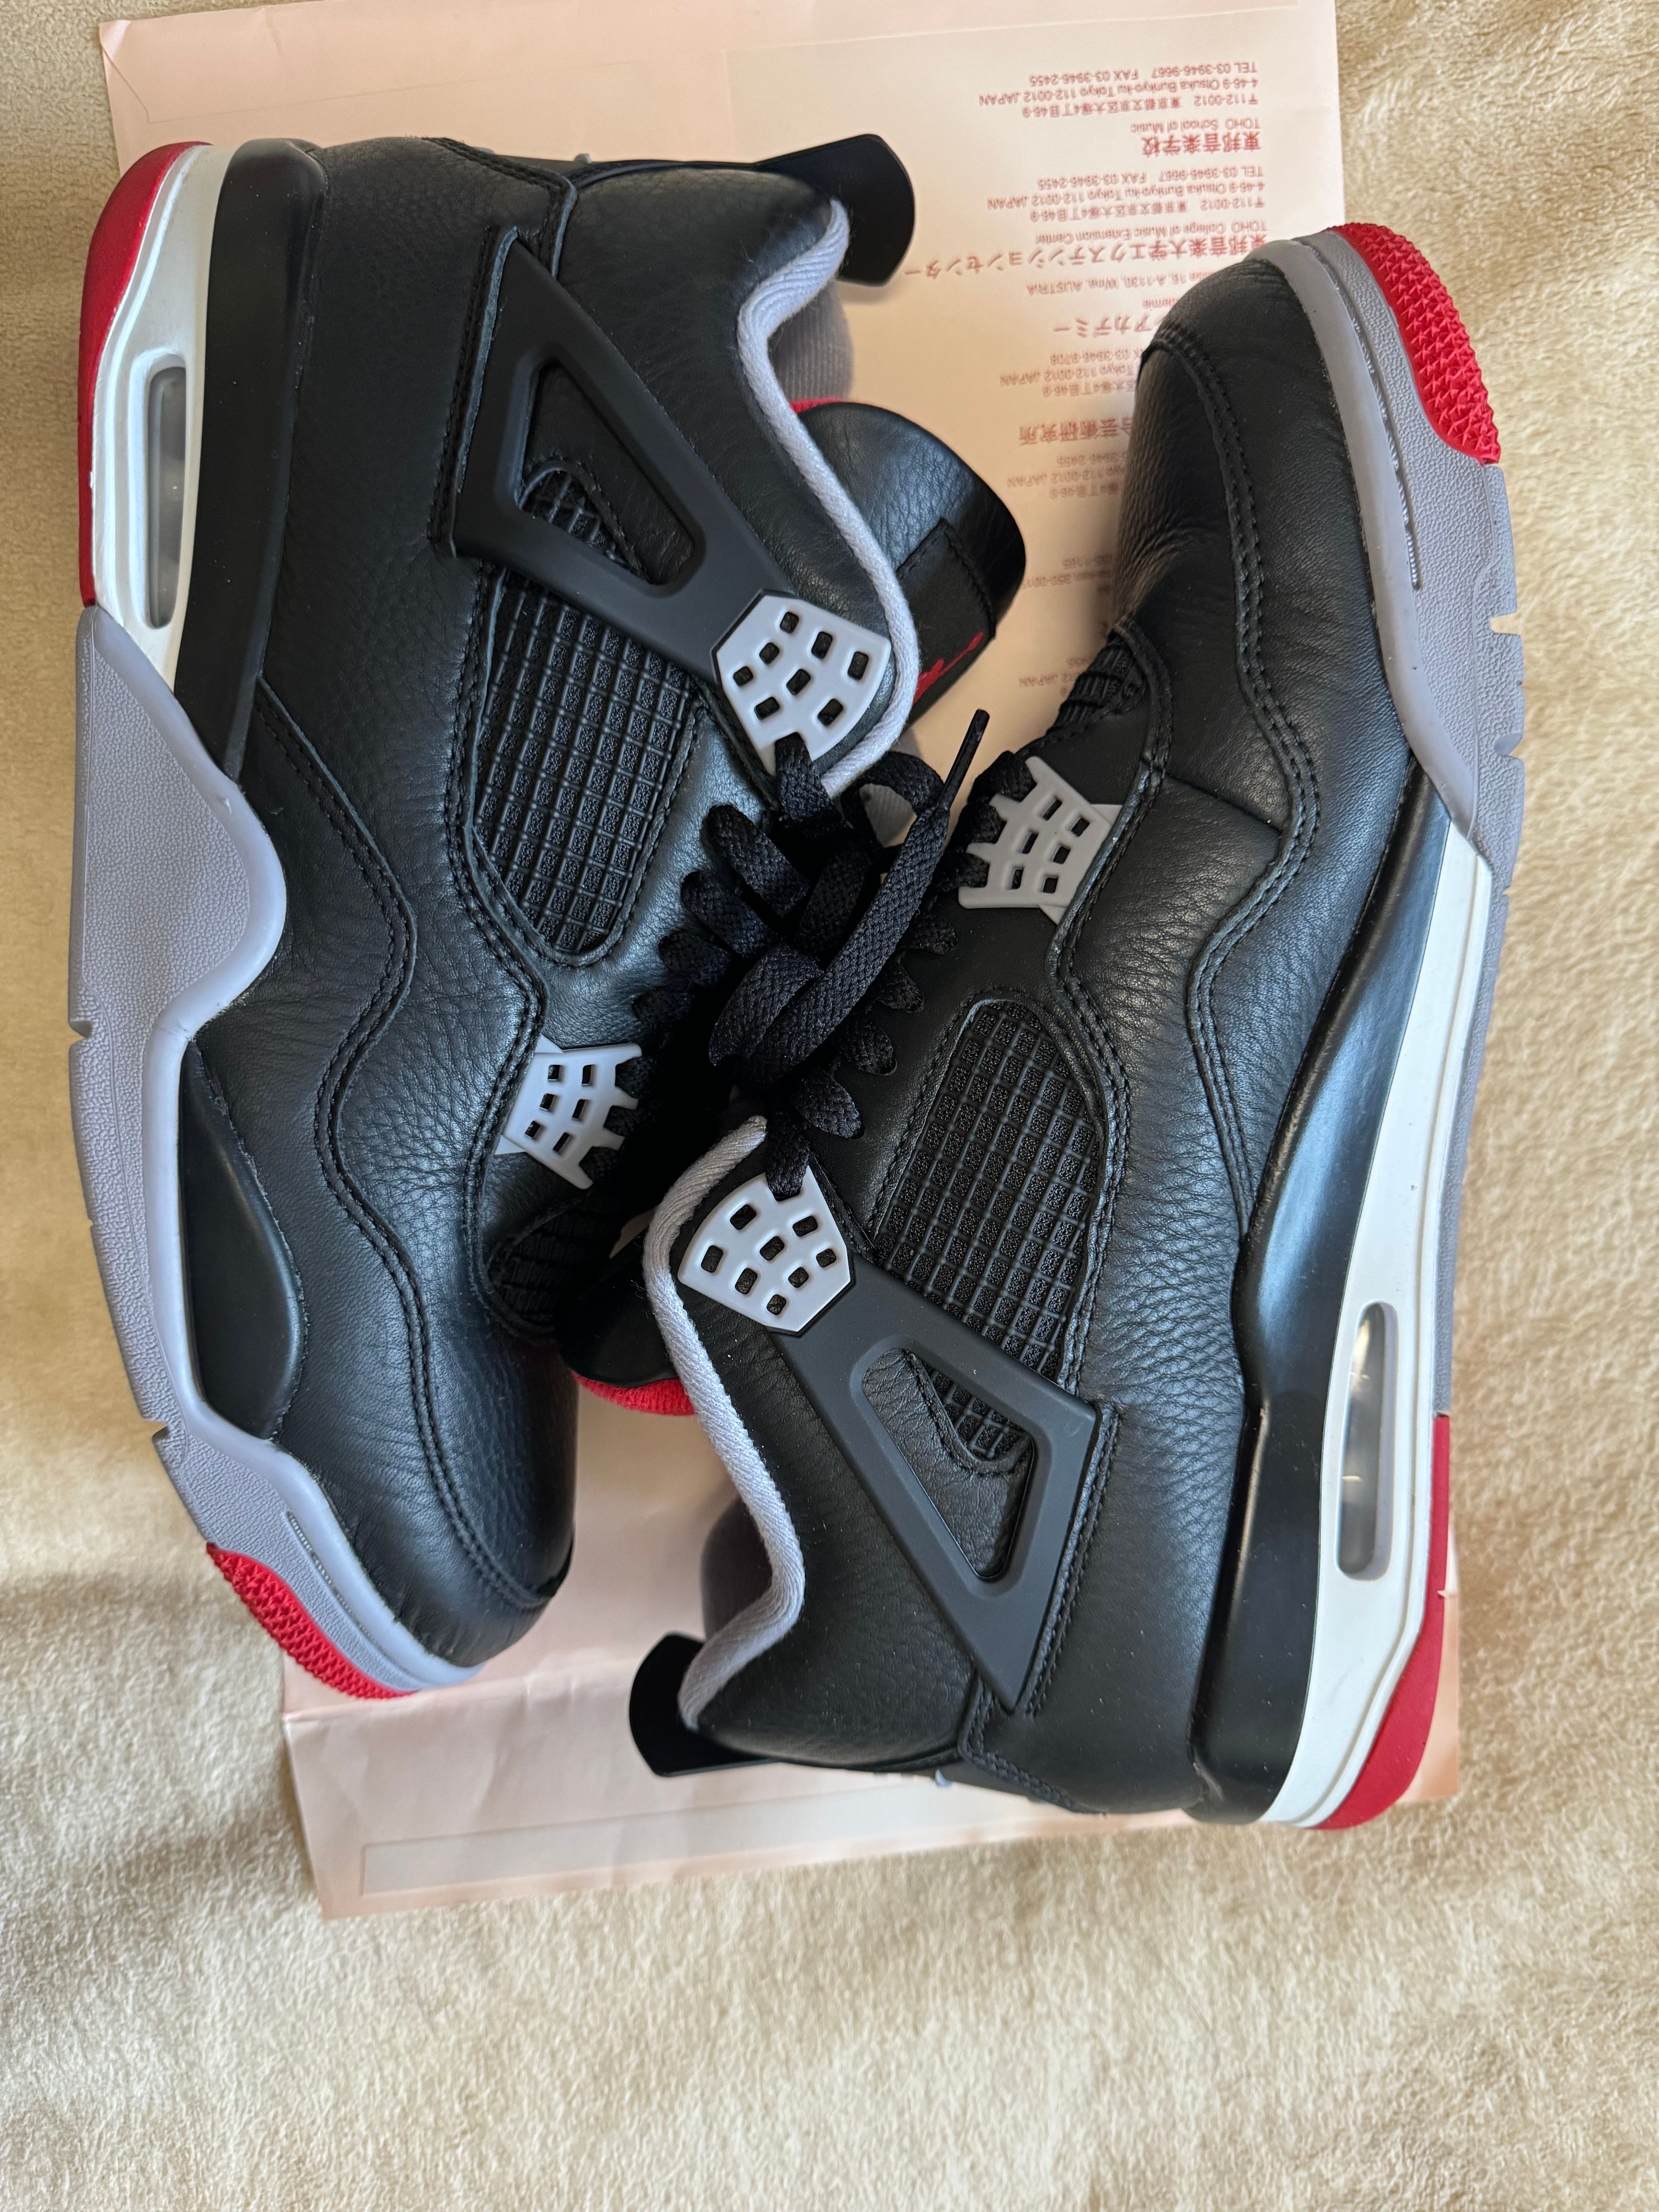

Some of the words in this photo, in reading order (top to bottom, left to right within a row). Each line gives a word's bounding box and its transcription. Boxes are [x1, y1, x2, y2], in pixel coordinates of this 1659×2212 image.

[1151, 63, 1231, 79] 03-3946-9667
[1233, 62, 1257, 74] TEL
[1029, 71, 1111, 87] 03-3946-2455
[1113, 69, 1139, 81] FAX
[1117, 81, 1178, 95] Bunkyo-ku
[1180, 79, 1220, 91] Otsuka
[1222, 78, 1259, 89] 4-46-9
[1023, 88, 1077, 103] 112-0012
[1080, 85, 1115, 98] Tokyo
[979, 92, 1021, 107] JAPAN
[1130, 123, 1164, 134] Music
[1167, 121, 1178, 133] of
[1180, 120, 1219, 132] School
[1225, 118, 1260, 130] TOHO
[1141, 132, 1261, 158] 東邦音楽学校
[1240, 166, 1264, 178] TEL
[1121, 173, 1146, 185] FAX
[1125, 185, 1183, 198] Bunkyo-ku
[1187, 183, 1227, 195] Otsuka
[1228, 181, 1265, 193] 4-46-9
[1030, 192, 1085, 207] 112-0012
[1087, 189, 1122, 202] Tokyo
[987, 196, 1028, 211] JAPAN
[1133, 226, 1168, 239] Music
[1170, 225, 1181, 238] of
[1183, 222, 1226, 234] College
[1231, 220, 1267, 232] TOHO
[1036, 232, 1074, 245] Center
[1075, 229, 1131, 242] Extension
[1025, 280, 1083, 297] AUSTRIA
[1000, 371, 1041, 387] JAPAN
